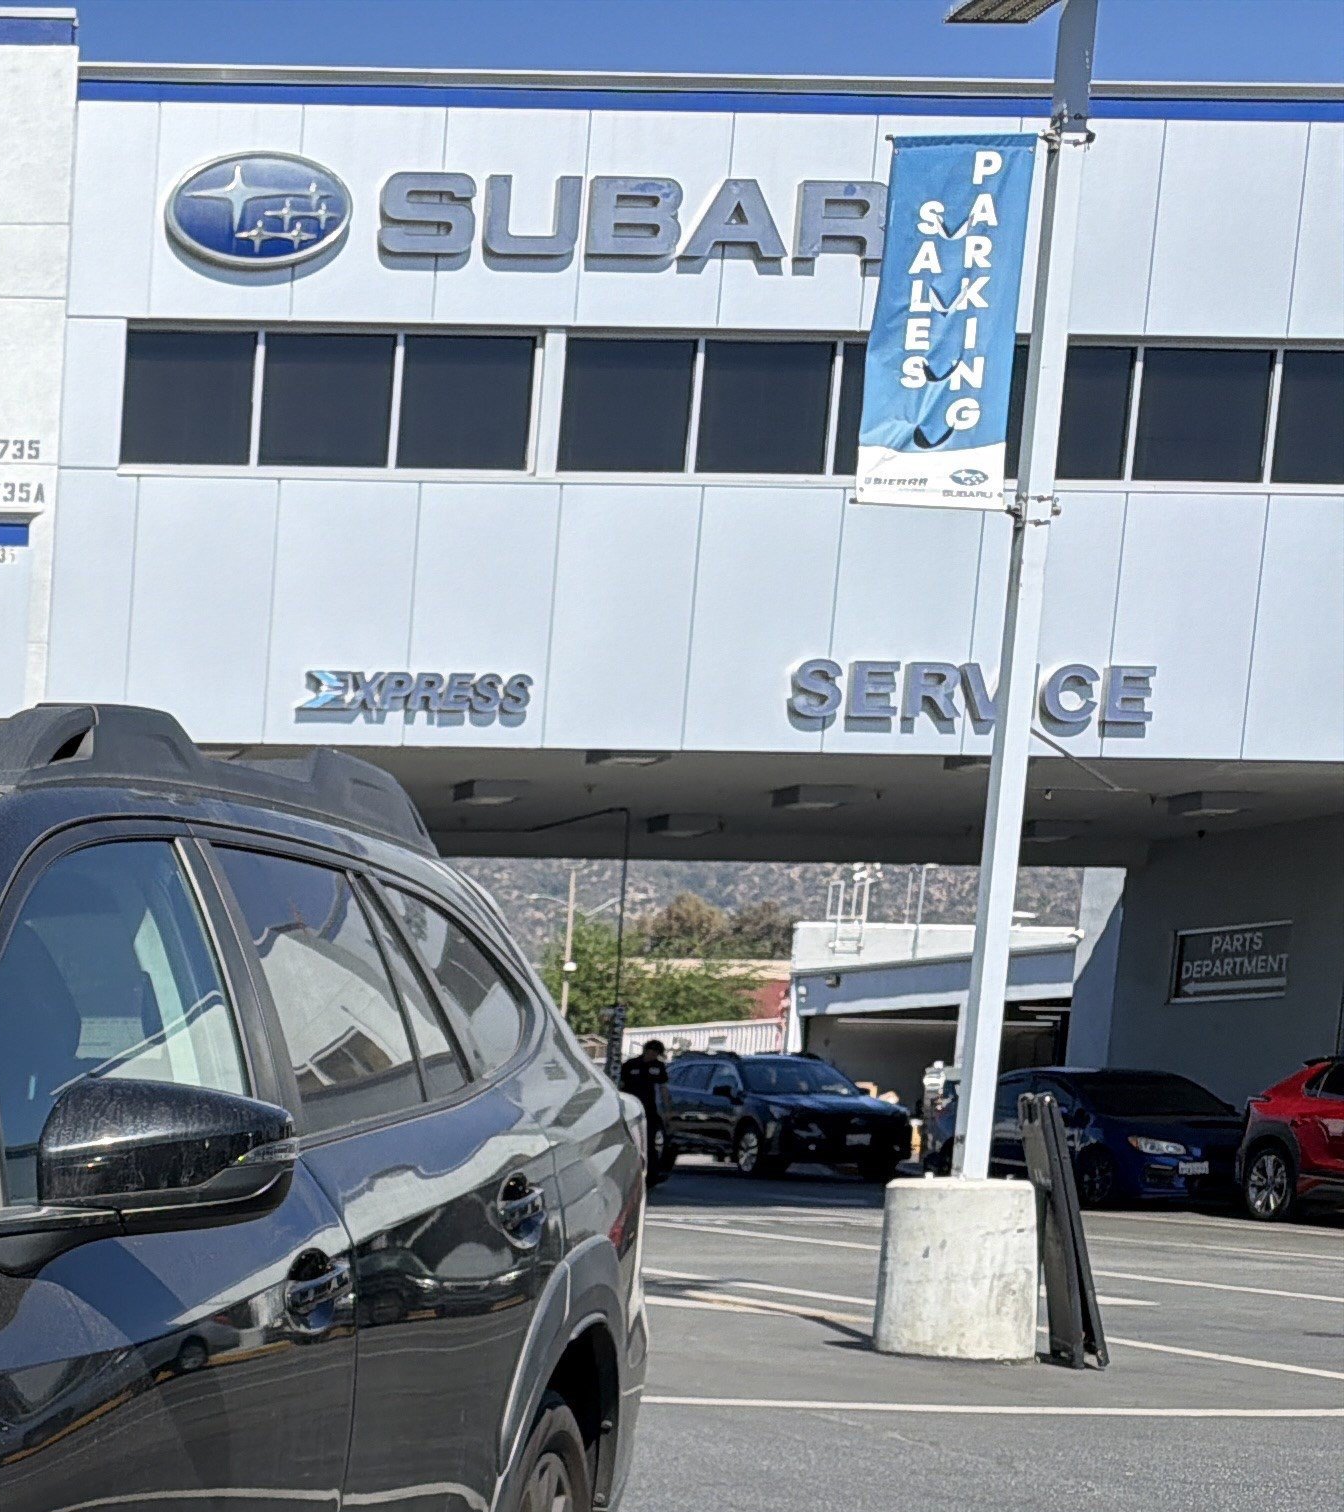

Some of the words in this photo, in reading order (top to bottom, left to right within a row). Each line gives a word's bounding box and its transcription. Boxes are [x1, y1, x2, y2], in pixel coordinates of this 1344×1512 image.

[378, 171, 888, 273] SUBAR
[900, 200, 945, 389] SALES
[945, 150, 1003, 430] PARKING
[296, 669, 534, 725] EXPRESS
[788, 658, 1157, 735] SERVCE
[1181, 953, 1289, 980] DEPARTMENT
[1211, 931, 1263, 953] PARTS
